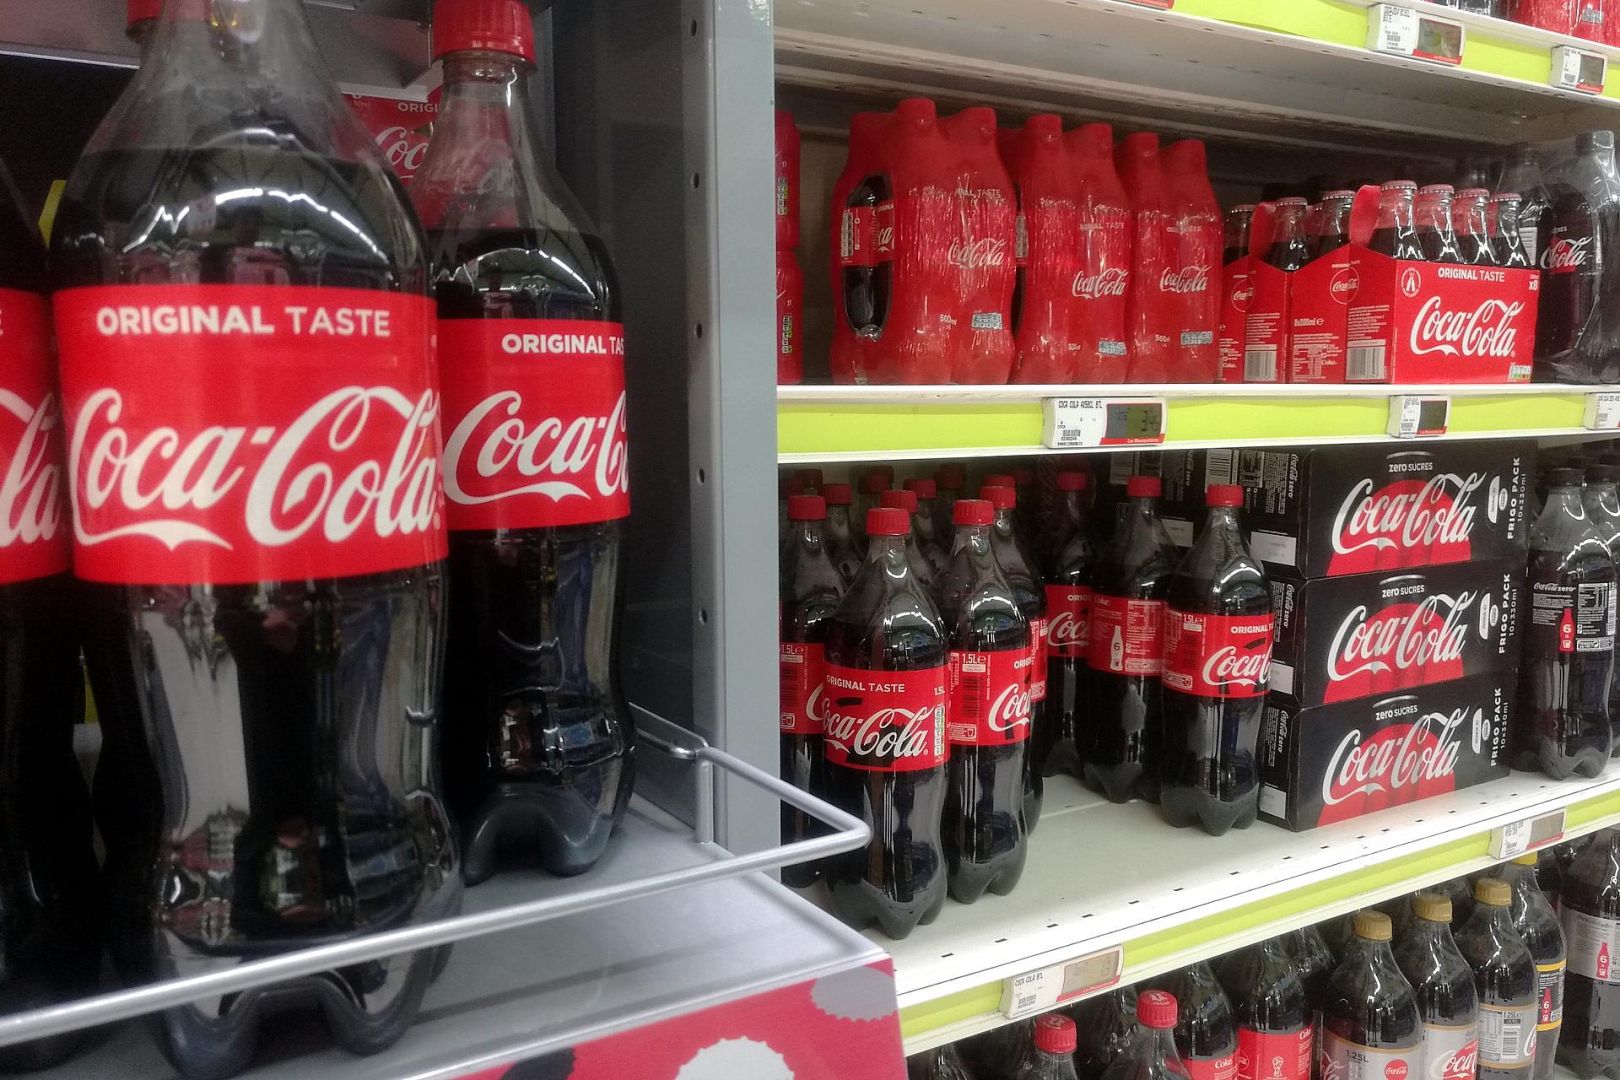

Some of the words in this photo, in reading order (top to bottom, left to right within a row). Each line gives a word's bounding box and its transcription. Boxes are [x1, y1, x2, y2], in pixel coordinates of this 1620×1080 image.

[398, 103, 438, 112] ORIGI
[375, 127, 429, 178] Coc
[1072, 268, 1128, 299] Coca-Cola
[1160, 265, 1211, 294] Coca-Cola
[1438, 267, 1477, 280] ORIGINAL
[1479, 269, 1505, 283] TASTE
[1529, 280, 1538, 291] x8
[97, 306, 275, 336] ORIGINAL
[285, 307, 391, 337] TASTE
[1410, 296, 1525, 357] Coca-Cola
[502, 333, 606, 354] ORIGINAL
[609, 336, 624, 355] TAS
[1058, 400, 1068, 409] COCA
[1069, 400, 1079, 409] COLA
[69, 386, 439, 551] Coca-Cola
[1389, 463, 1407, 473] zero
[1408, 462, 1433, 472] SUCRES
[1511, 457, 1520, 493] PACK
[1332, 471, 1487, 555] Coca-Cola
[1517, 473, 1526, 522] 10x330ml
[1507, 498, 1517, 539] FRIGO
[1382, 587, 1400, 598] zero
[1400, 584, 1425, 596] SUCRES
[1502, 573, 1511, 608] PACK
[1509, 588, 1517, 636] 10x330ml
[1230, 624, 1268, 634] ORIGINAL
[1327, 590, 1478, 682] Coca-Cola
[1499, 613, 1508, 654] FRIGO
[1562, 624, 1571, 634] 6
[1113, 642, 1120, 650] 6
[826, 674, 866, 691] ORIGINAL
[868, 683, 905, 693] TASTE
[988, 683, 1031, 732] Coca
[1375, 710, 1394, 721] zero
[1394, 704, 1418, 717] SUCRES
[1494, 687, 1502, 722] PACK
[1501, 702, 1509, 749] 10x330ml
[1322, 706, 1470, 806] Coca-Cola
[1490, 728, 1500, 767] FRIGO
[1026, 974, 1035, 983] COLA
[1543, 1001, 1550, 1009] 6
[1344, 1049, 1368, 1063] 1.25L
